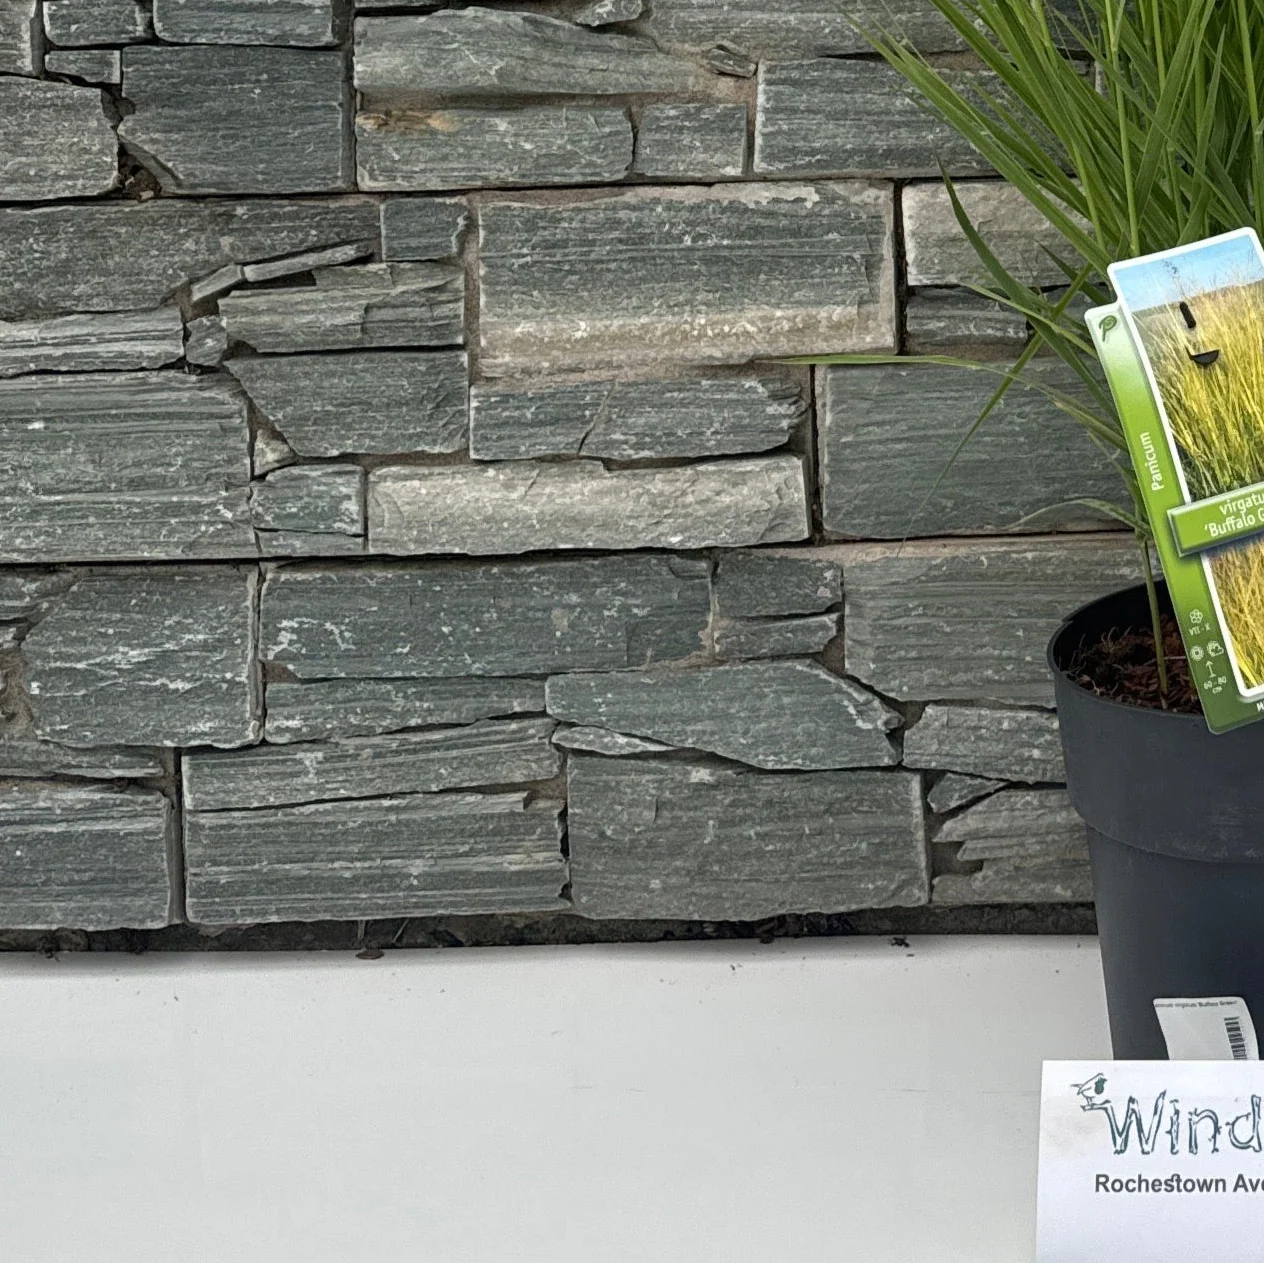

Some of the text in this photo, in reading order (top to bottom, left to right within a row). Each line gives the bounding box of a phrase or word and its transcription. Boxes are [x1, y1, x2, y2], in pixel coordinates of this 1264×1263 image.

[1140, 431, 1165, 492] Panicum
[1204, 513, 1256, 538] 'Buffalo
[1095, 1173, 1227, 1194] Rochestown
